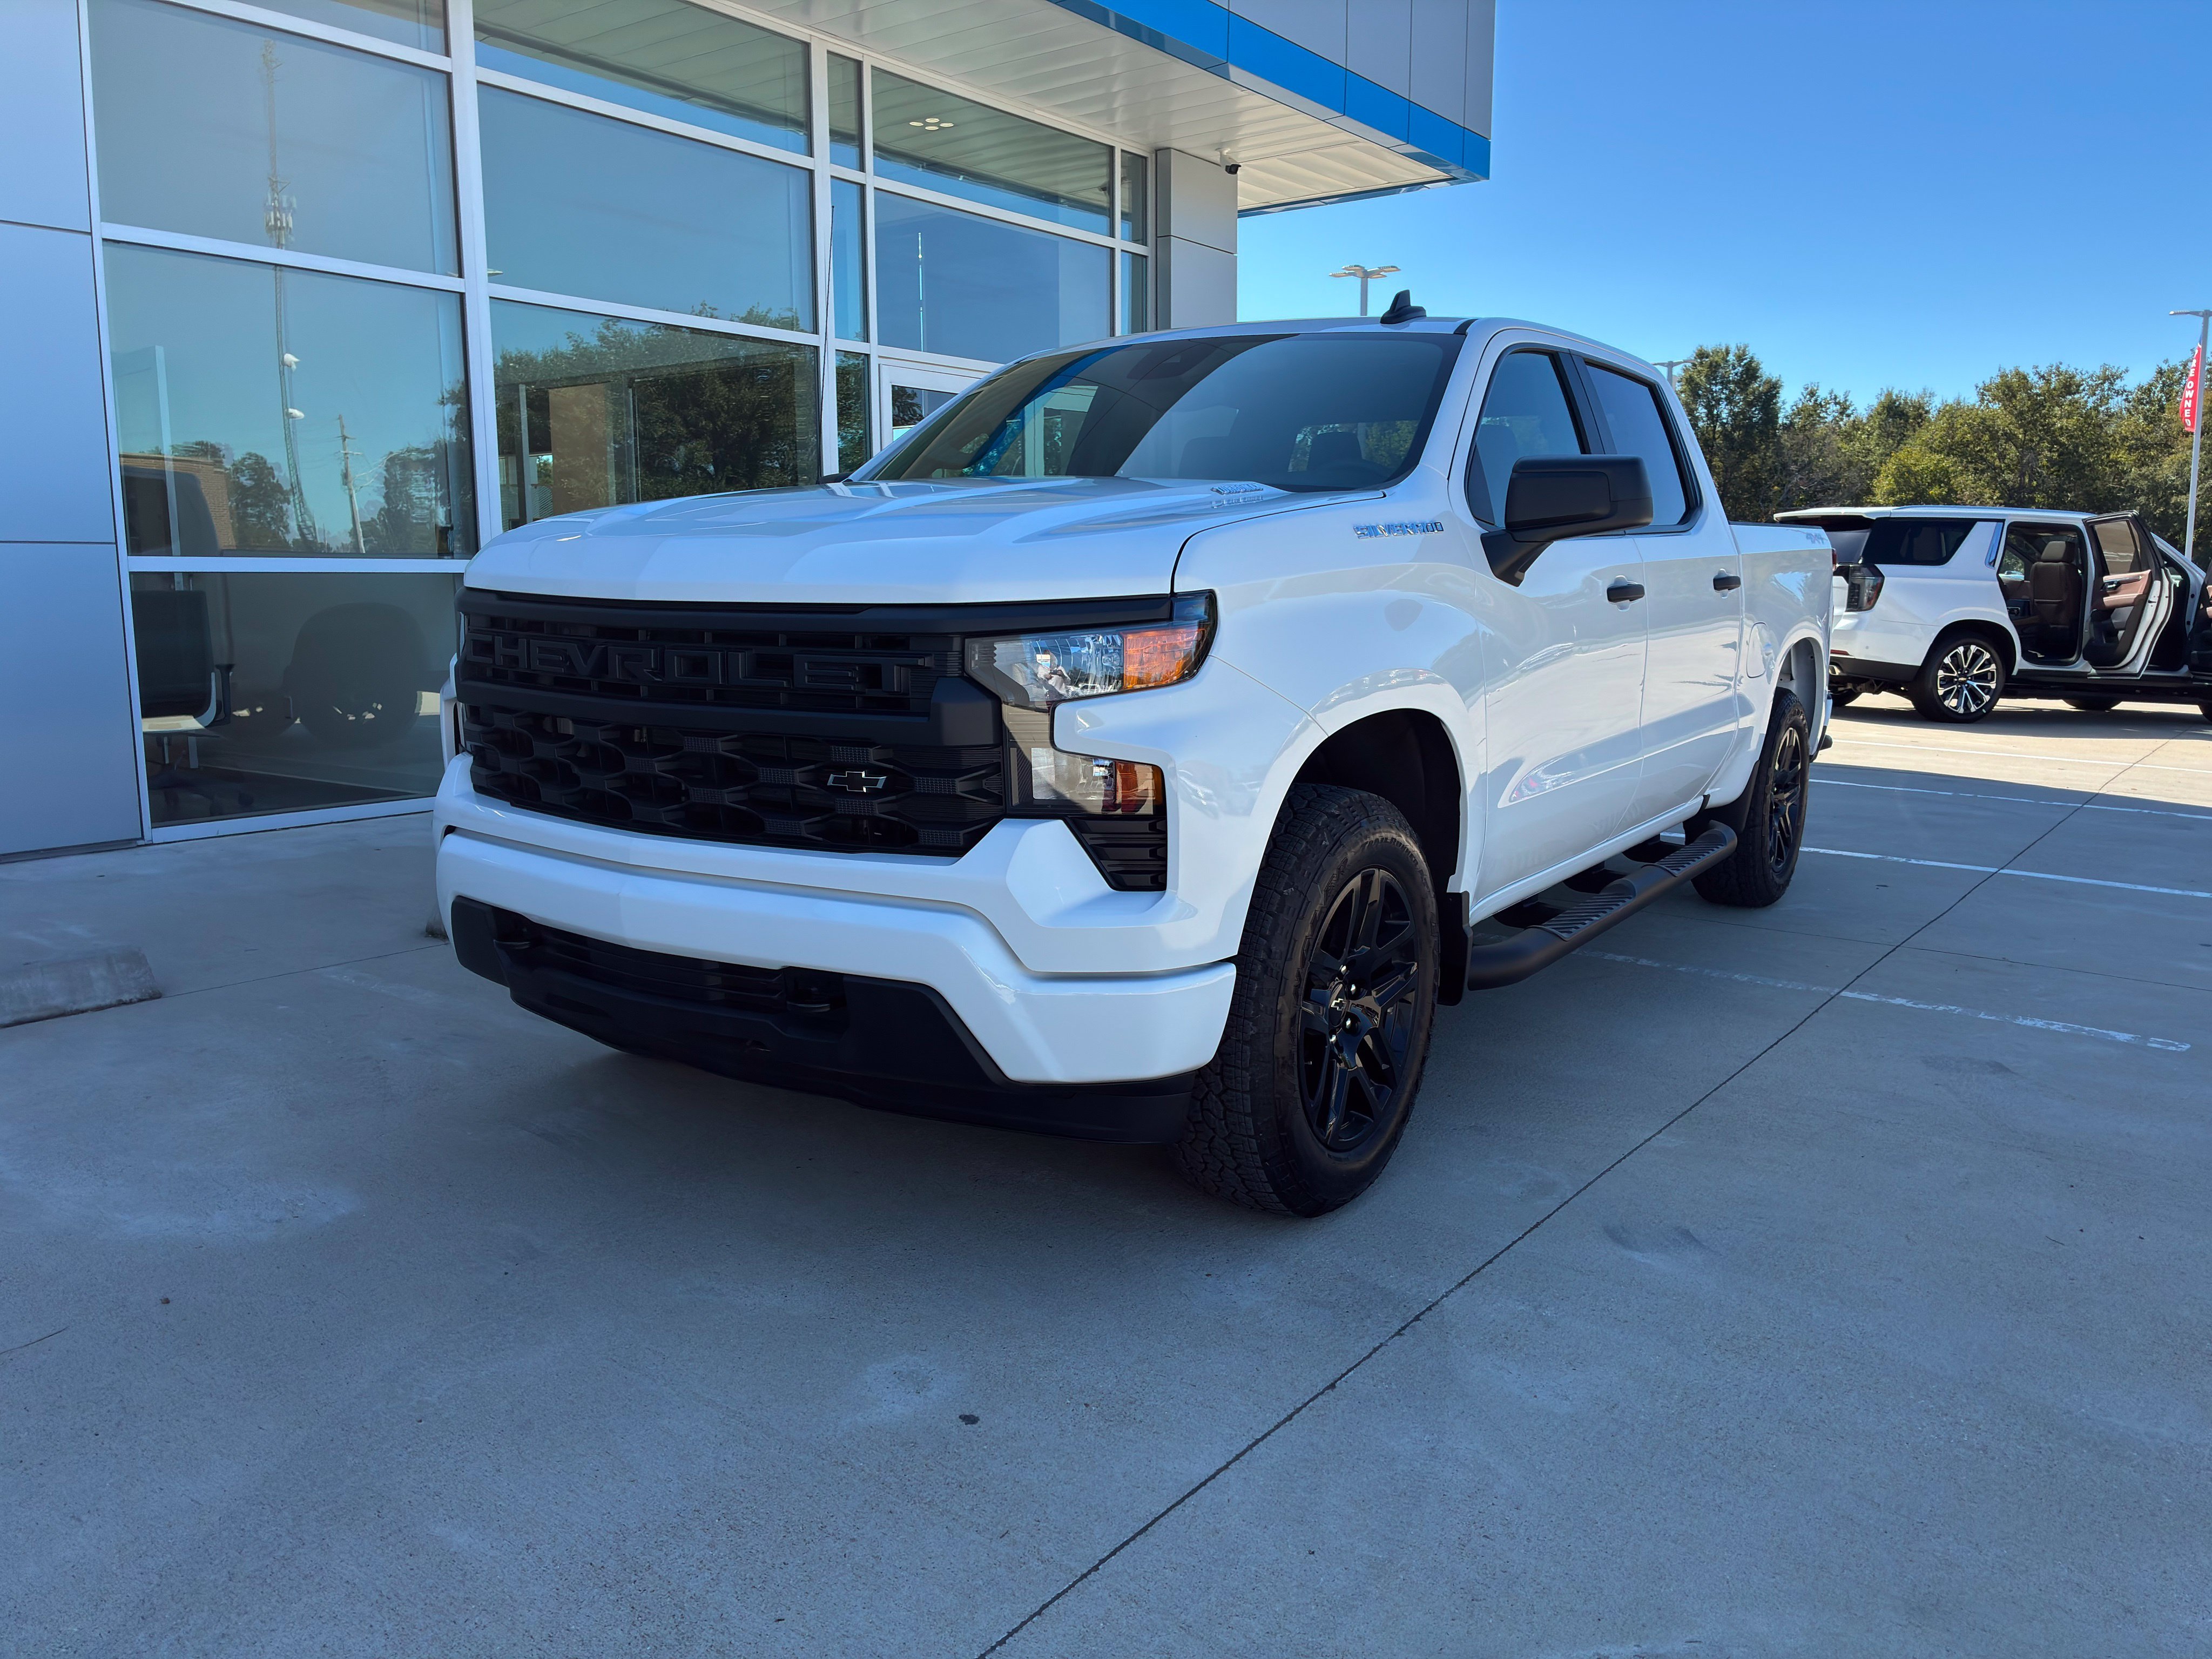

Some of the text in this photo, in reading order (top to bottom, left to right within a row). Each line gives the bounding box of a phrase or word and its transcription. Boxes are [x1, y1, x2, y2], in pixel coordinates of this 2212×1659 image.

[2184, 381, 2194, 426] OWNED
[1353, 522, 1444, 539] SILVERADO
[465, 632, 934, 693] CHEVROLET
